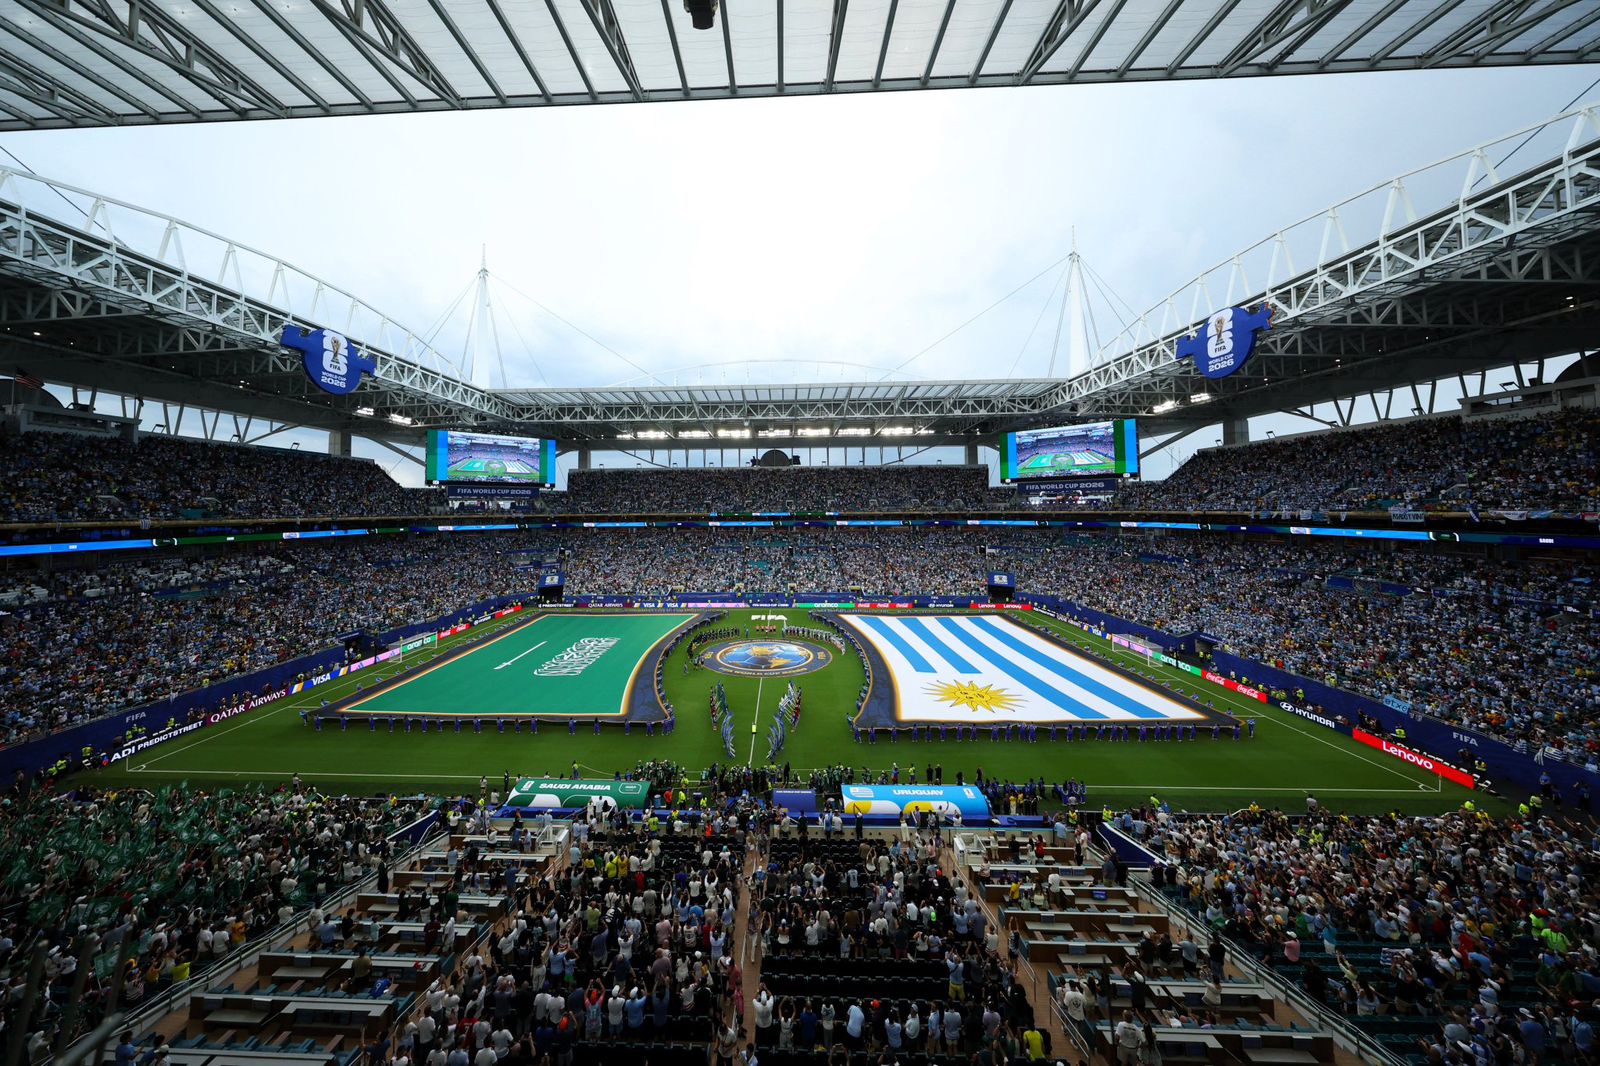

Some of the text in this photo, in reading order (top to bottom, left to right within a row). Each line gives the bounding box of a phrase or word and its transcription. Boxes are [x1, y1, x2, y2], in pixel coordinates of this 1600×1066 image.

[1215, 345, 1226, 353] FIFA
[330, 363, 341, 371] FIFA
[1208, 359, 1234, 372] 2026
[321, 376, 346, 388] 2026
[312, 672, 331, 686] VISA
[211, 689, 286, 723] QATAR AIRWAYS
[126, 711, 146, 723] FIFA
[1295, 707, 1335, 728] HYUNDAI
[110, 720, 203, 762] ADI PREDICTSTREET
[1452, 731, 1479, 747] FIFA
[1382, 740, 1433, 770] Lenovo
